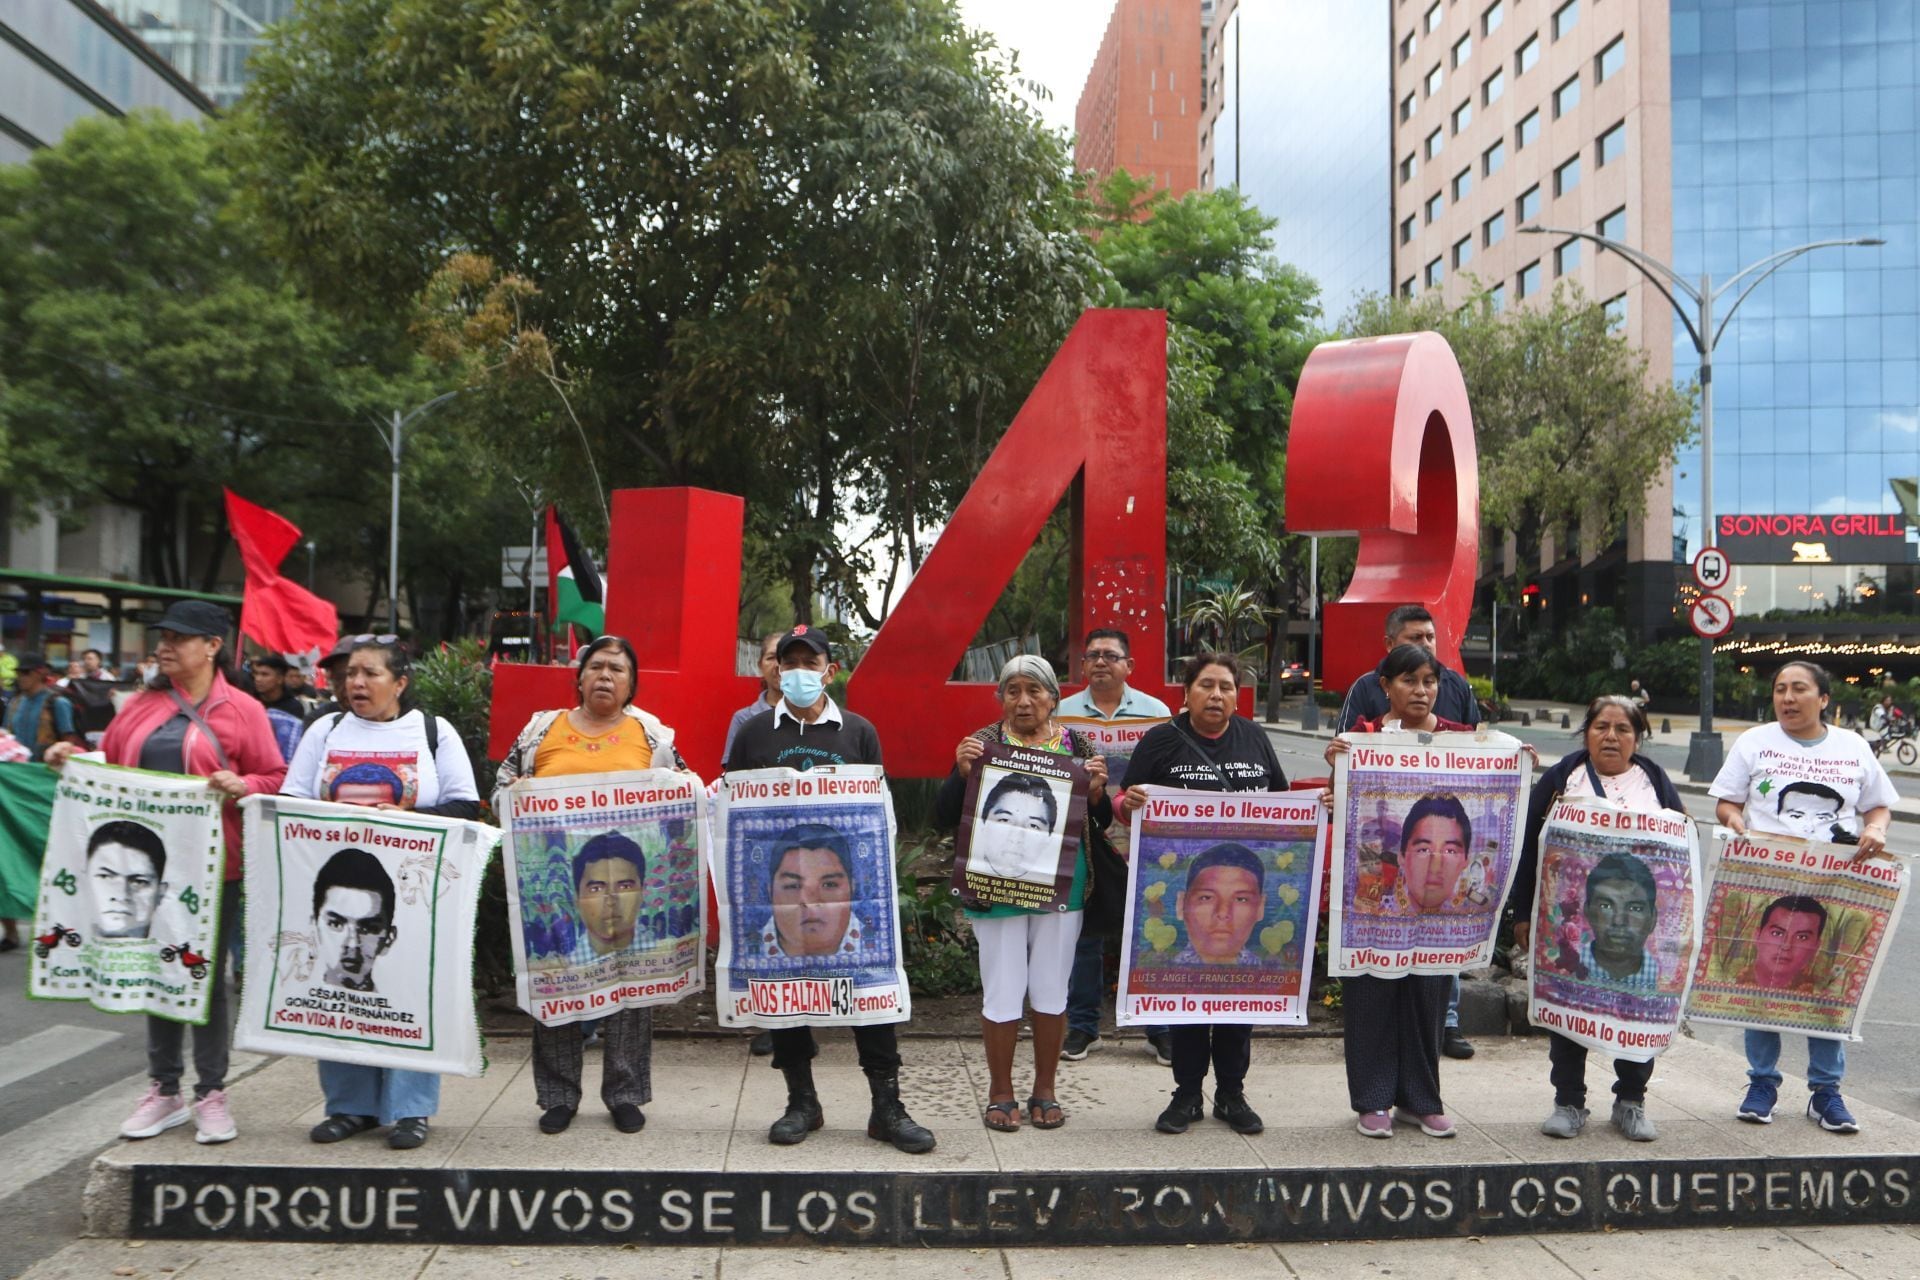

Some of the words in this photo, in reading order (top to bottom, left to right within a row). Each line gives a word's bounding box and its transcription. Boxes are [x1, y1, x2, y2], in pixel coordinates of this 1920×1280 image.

[1719, 514, 1827, 536] SONORA
[1831, 514, 1905, 536] GRILL
[1085, 730, 1096, 740] e
[1100, 730, 1113, 743] lo
[1117, 729, 1147, 743] llev
[990, 756, 1031, 771] Santana
[1031, 763, 1072, 779] Maestro
[1010, 749, 1055, 766] Antonio
[1169, 764, 1193, 774] XXIII
[1196, 763, 1223, 772] ACCN
[1224, 762, 1252, 770] GLOBAL
[1351, 749, 1395, 770] ¡Vivo
[1399, 754, 1420, 769] se
[1425, 751, 1440, 768] lo
[1445, 752, 1519, 771] llevaron!
[1801, 756, 1812, 764] lo
[1814, 757, 1860, 767] llevaron!
[1179, 772, 1220, 781] AYOTZINA
[1228, 771, 1234, 779] Y
[1765, 767, 1810, 780] CAMPOS
[1812, 774, 1854, 786] CANTOR
[731, 779, 768, 802] ¡Vivo
[772, 782, 791, 797] se
[796, 778, 813, 797] lo
[817, 776, 881, 795] llevaron!
[95, 795, 113, 808] se
[116, 796, 132, 811] lo
[136, 799, 211, 817] llevaron!
[513, 795, 560, 819] ¡Vivo
[564, 795, 587, 810] se
[591, 789, 609, 808] lo
[613, 782, 693, 806] llevaron!
[1145, 800, 1190, 820] ¡Vivo
[1193, 803, 1216, 819] se
[1219, 801, 1236, 818] lo
[1241, 802, 1317, 821] llevaron!
[1553, 803, 1587, 824] ¡Vivo
[1590, 810, 1611, 828] se
[1615, 811, 1632, 829] lo
[1636, 813, 1687, 839] llevaron!
[284, 823, 322, 842] ¡Vivo
[324, 827, 341, 843] se
[343, 826, 361, 843] lo
[362, 827, 436, 853] llevaron!
[1724, 837, 1770, 860] ¡Vivo
[1774, 849, 1796, 863] se
[1800, 850, 1817, 867] lo
[1822, 854, 1899, 884] llevaron!
[52, 867, 78, 897] 43
[965, 872, 989, 884] Vivos
[990, 879, 1002, 887] se
[1003, 879, 1017, 889] los
[1018, 882, 1058, 897] llevaron,
[967, 881, 992, 893] Vivos
[993, 886, 1007, 895] los
[1008, 889, 1054, 903] queremos
[178, 885, 200, 916] 43
[976, 891, 988, 900] La
[989, 893, 1014, 904] lucha
[1015, 898, 1041, 909] sigue
[1356, 926, 1403, 938] ANTONIO
[1407, 926, 1446, 938] SATANA
[1449, 924, 1487, 937] MAESTRO
[1350, 949, 1391, 969] ¡Vivo
[1395, 951, 1409, 968] lo
[533, 974, 580, 986] EMILIANO
[583, 966, 606, 980] ALEN
[608, 959, 641, 972] GASPAR
[644, 959, 658, 967] DE
[662, 957, 675, 966] LA
[1131, 973, 1157, 983] LUIS
[1199, 973, 1255, 983] FRANCISCO
[1259, 974, 1298, 985] ARZOLA
[100, 972, 113, 987] lo
[115, 975, 187, 996] queremos!
[308, 986, 347, 1001] CÉSAR
[347, 993, 393, 1009] MANUEL
[540, 997, 586, 1020] ¡Vivo
[590, 994, 605, 1009] lo
[609, 971, 690, 1004] queremos!
[749, 981, 779, 1015] NOS
[781, 980, 832, 1014] FALTAN
[831, 978, 854, 1017] 43!
[852, 991, 898, 1013] remos!
[1135, 996, 1176, 1016] ¡Vivo
[1181, 997, 1197, 1012] lo
[1201, 997, 1288, 1016] queremos!
[1763, 1000, 1803, 1013] CAMPOS
[284, 995, 346, 1014] GONZÁLEZ
[347, 1004, 416, 1025] HERNÁNDEZ
[273, 1008, 304, 1025] ¡Con
[305, 1011, 338, 1030] VIDA
[339, 1015, 355, 1031] lo
[355, 1020, 424, 1041] queremos!
[1538, 1007, 1562, 1028] ¡Con
[1565, 1014, 1597, 1038] VIDA
[1600, 1022, 1614, 1041] lo
[1617, 1029, 1673, 1049] queremos!
[152, 1183, 421, 1232] PORQUE
[443, 1186, 635, 1233] VIVOS
[658, 1189, 736, 1233] SE
[760, 1189, 879, 1234] LOS
[911, 1184, 1236, 1232] LLEVARON
[1277, 1178, 1454, 1225] VIVOS
[1477, 1176, 1583, 1221] LOS
[1605, 1167, 1912, 1217] QUEREMOS
